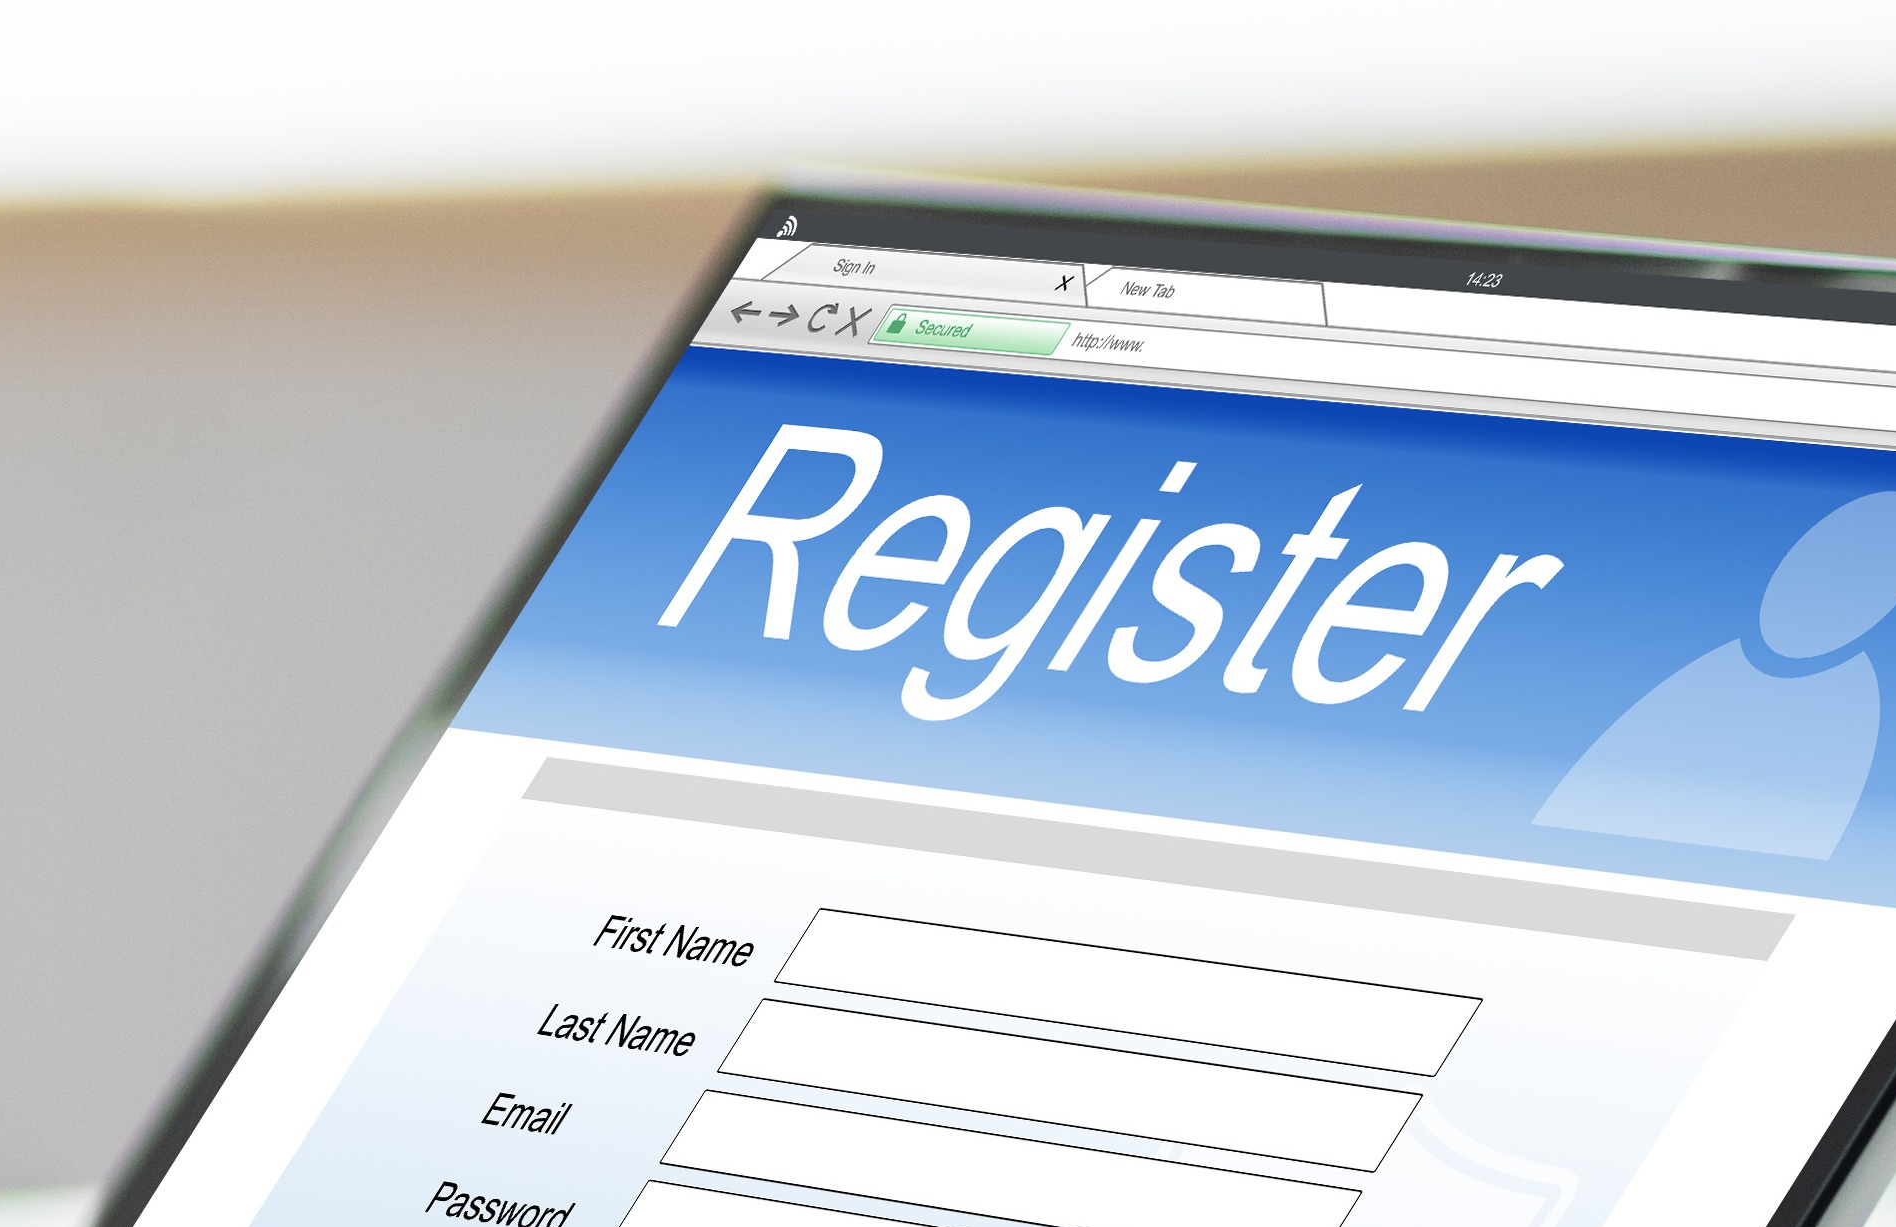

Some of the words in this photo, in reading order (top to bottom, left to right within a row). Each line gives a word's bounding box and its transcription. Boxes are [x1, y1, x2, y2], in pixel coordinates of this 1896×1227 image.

[833, 258, 862, 277] Sign
[861, 260, 876, 275] In
[1119, 281, 1152, 297] New
[1152, 283, 1176, 299] Tab
[1465, 271, 1504, 288] 14:23
[915, 319, 974, 338] Secured
[1071, 331, 1145, 353] http://www.
[656, 422, 1566, 723] Register
[592, 914, 667, 955] First
[662, 924, 755, 967] Name
[536, 1003, 609, 1044] Last
[604, 1013, 696, 1057] Name
[480, 1092, 574, 1135] Email
